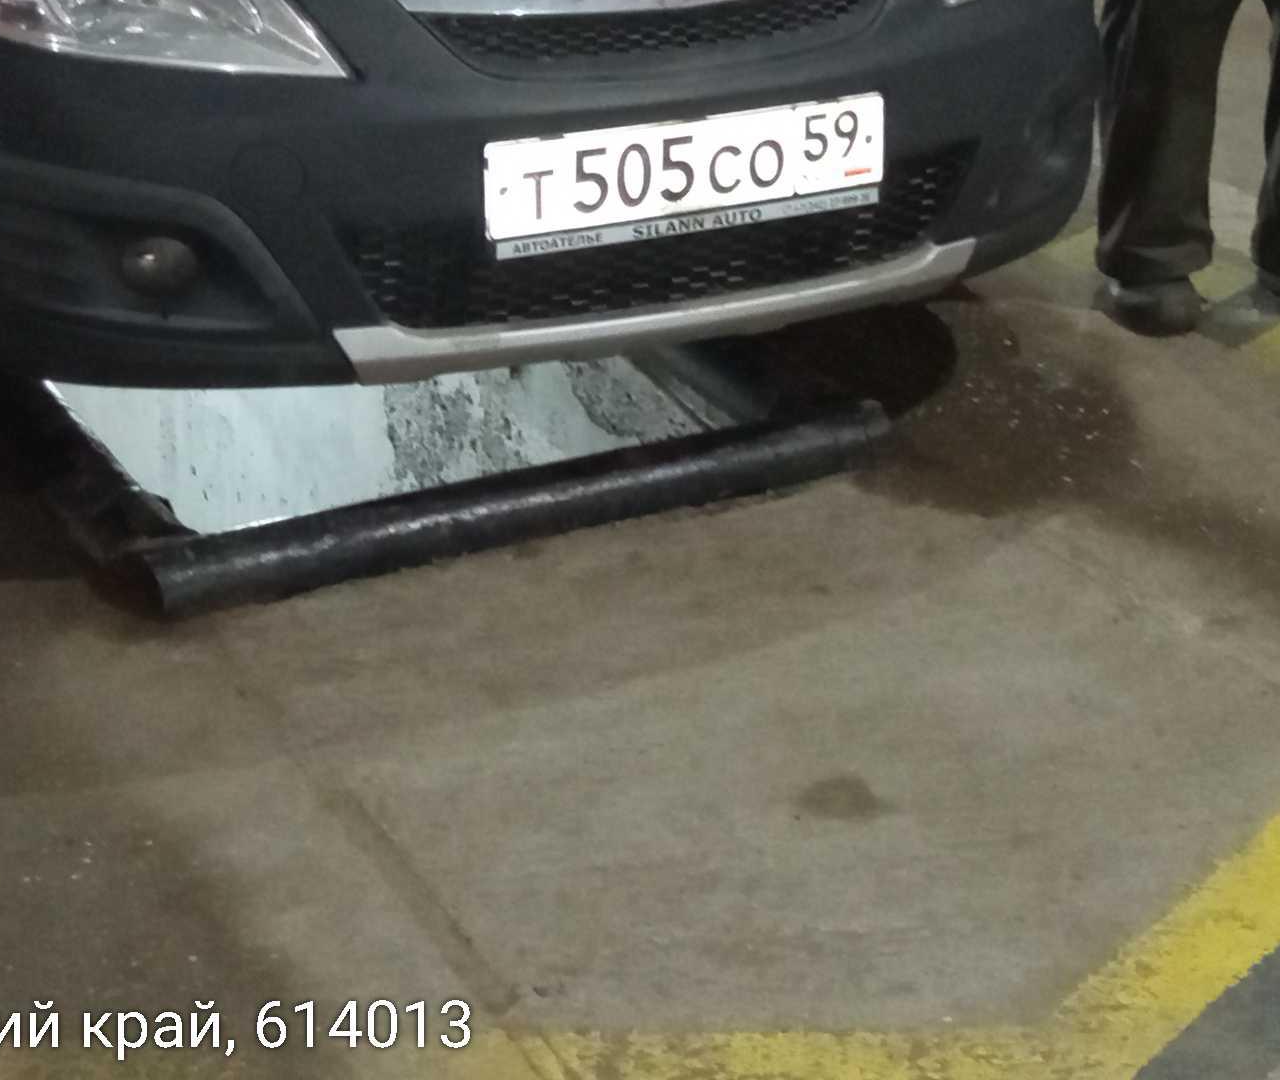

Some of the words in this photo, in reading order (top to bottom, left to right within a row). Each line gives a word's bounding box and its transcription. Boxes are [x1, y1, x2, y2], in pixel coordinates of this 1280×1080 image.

[803, 110, 858, 162] 59
[513, 233, 603, 255] АВТОАТЕЛЬЕ
[633, 217, 704, 240] SILANN
[712, 209, 762, 226] AUTO
